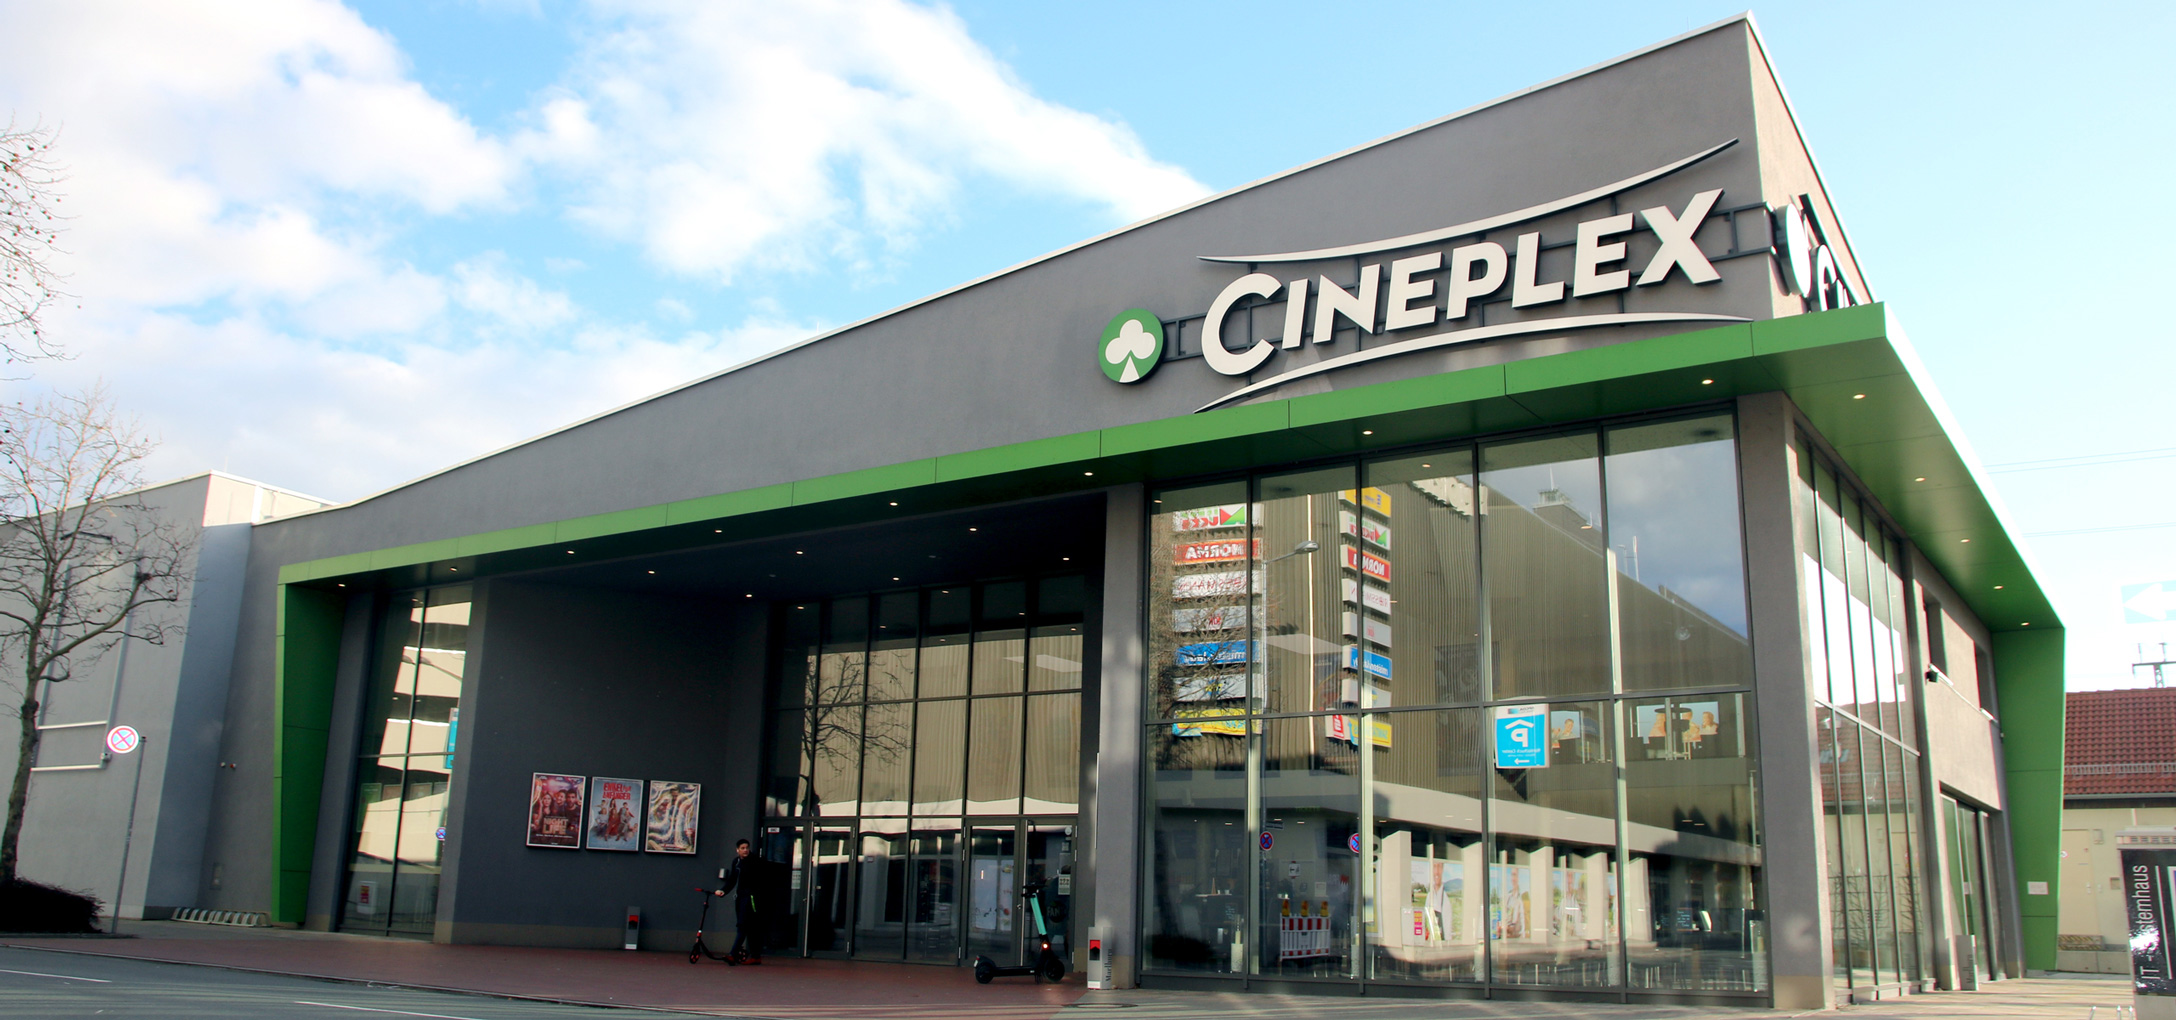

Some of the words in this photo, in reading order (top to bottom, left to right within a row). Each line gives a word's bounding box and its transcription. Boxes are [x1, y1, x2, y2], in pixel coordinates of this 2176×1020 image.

[1200, 187, 1724, 378] CINEPLEX
[543, 817, 569, 825] NIGHT
[542, 824, 567, 835] LIFE
